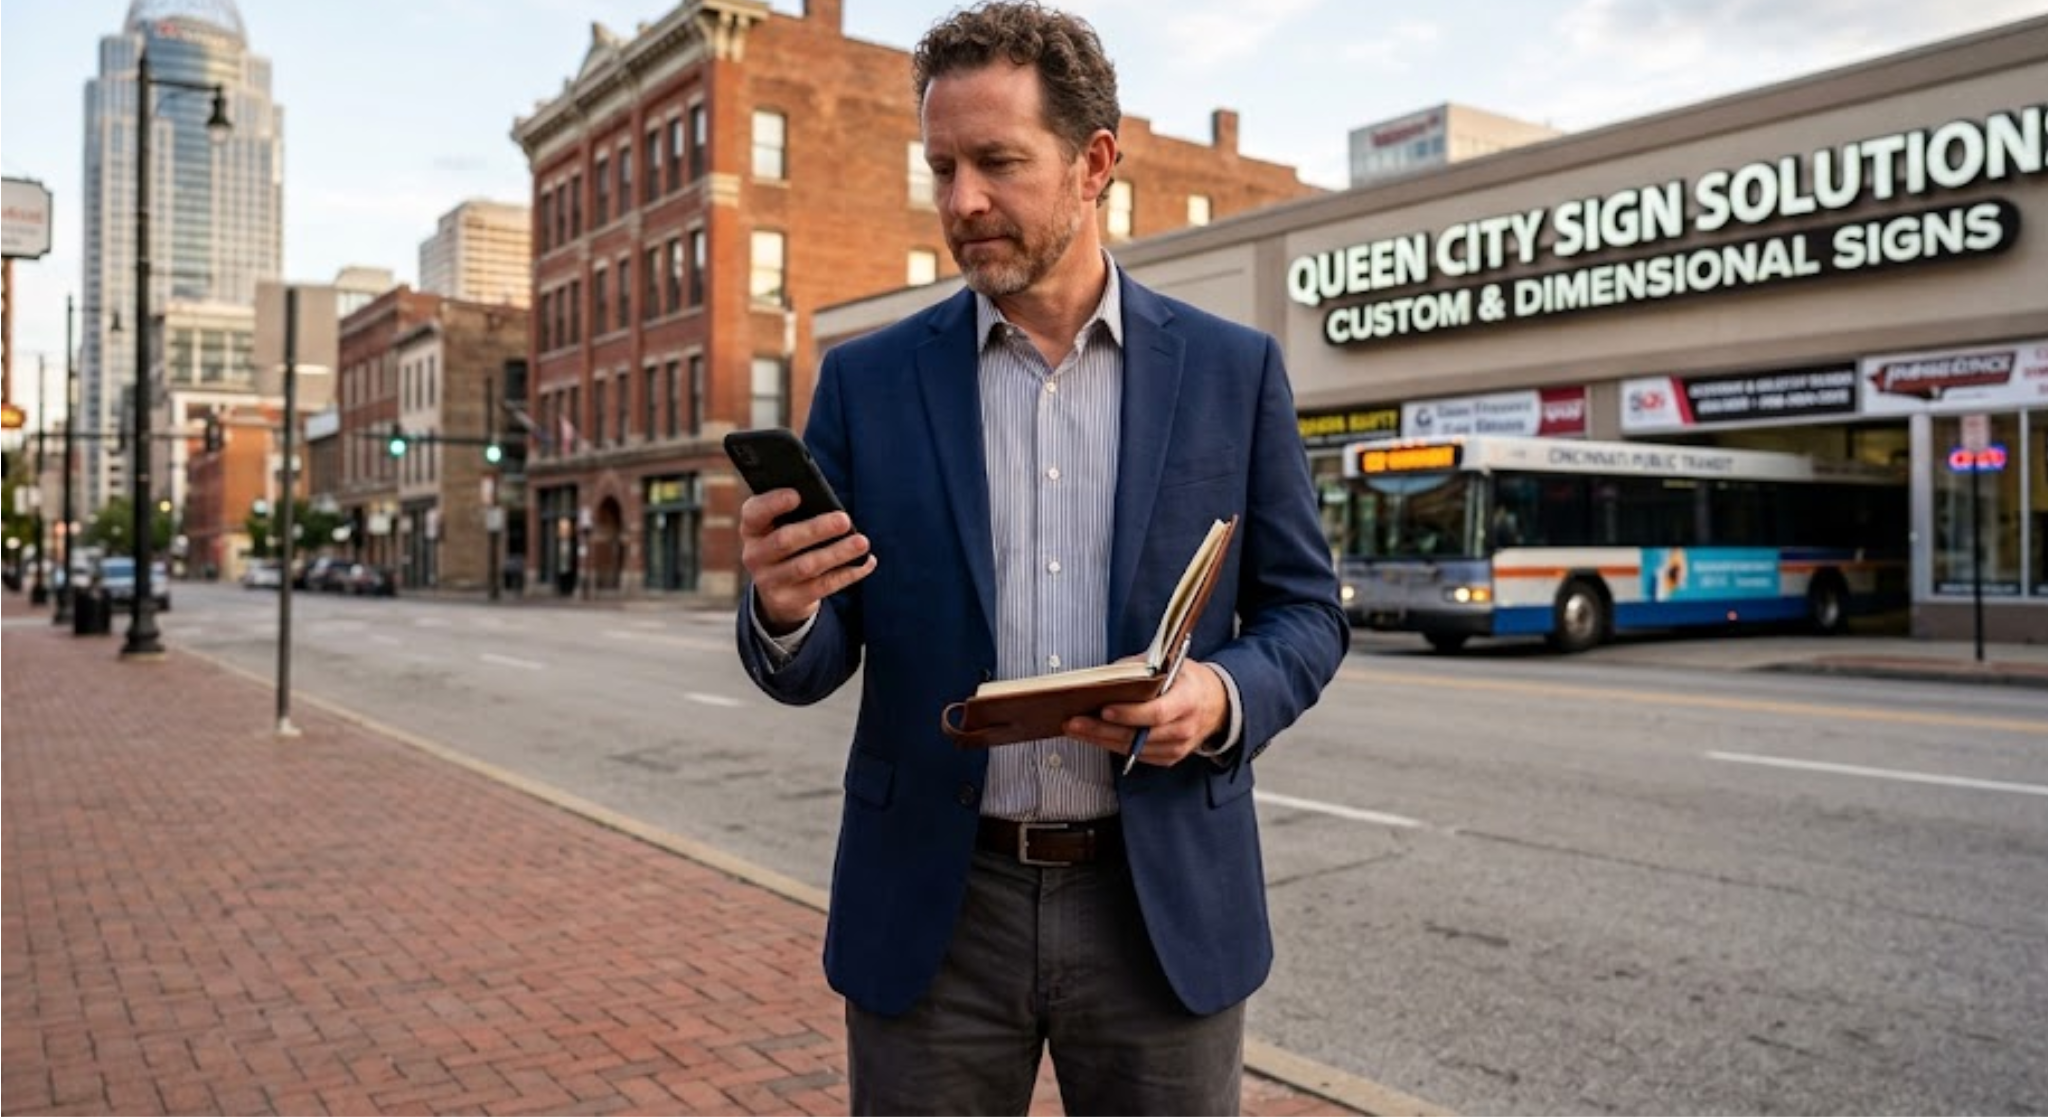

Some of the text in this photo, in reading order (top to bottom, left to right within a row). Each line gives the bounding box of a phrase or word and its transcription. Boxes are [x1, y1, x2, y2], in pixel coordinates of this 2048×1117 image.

[1287, 105, 2048, 306] QUEEN CITY SIGN SOLUTION
[1326, 203, 2003, 343] CUSTOM & DIMENSIONAL SIGNS
